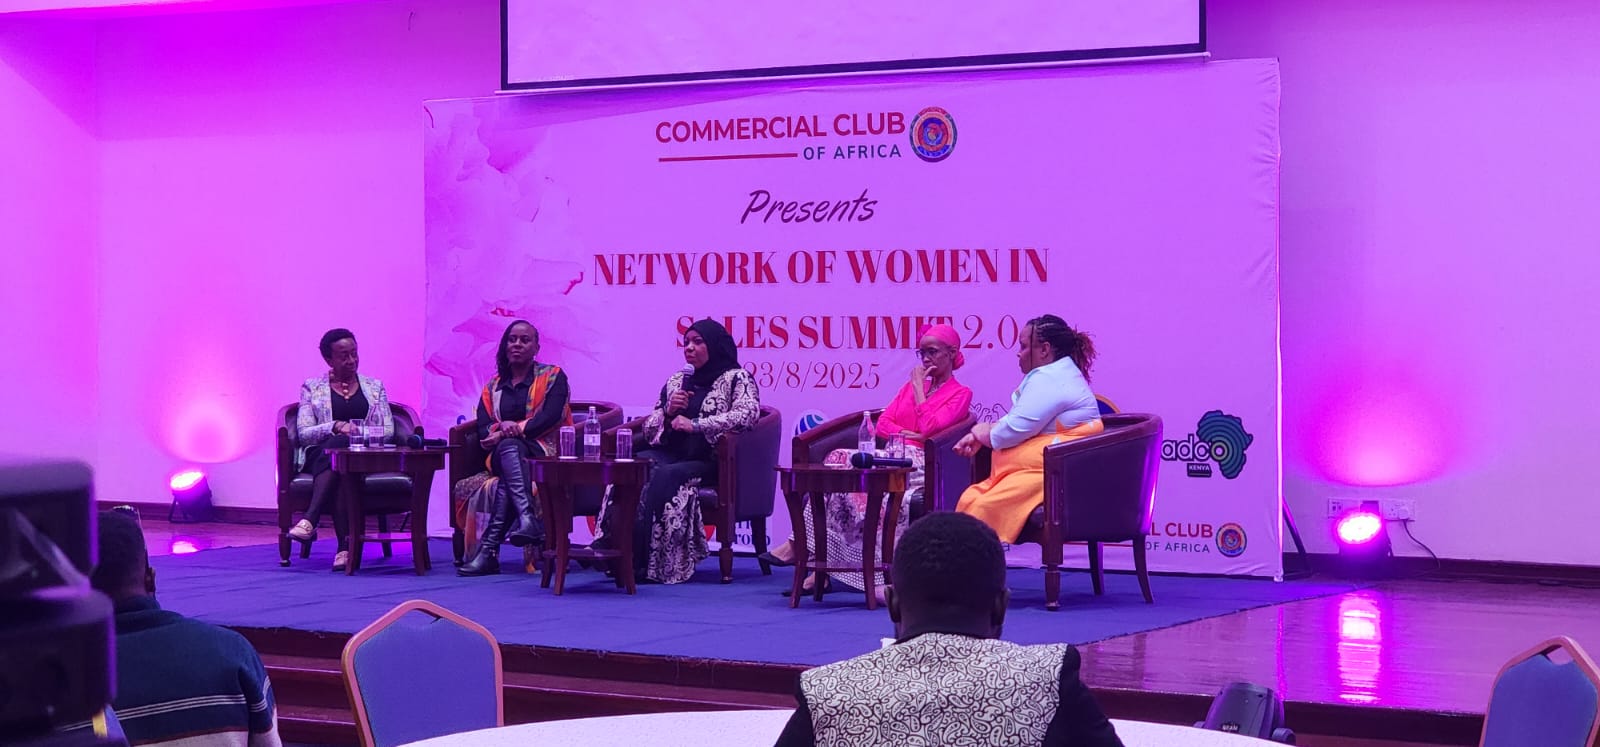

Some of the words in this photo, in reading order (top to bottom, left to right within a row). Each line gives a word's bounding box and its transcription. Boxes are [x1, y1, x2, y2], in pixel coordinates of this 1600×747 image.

[655, 115, 827, 144] COMMERCIAL
[833, 111, 906, 137] CLUB
[803, 146, 826, 160] OF
[833, 144, 902, 160] AFRICA
[740, 188, 879, 225] Presents
[593, 251, 780, 286] NETWORK
[787, 250, 836, 285] OF
[845, 248, 999, 284] WOMEN
[1008, 248, 1050, 283] IN
[676, 315, 789, 349] SLES
[798, 315, 953, 350] SUMMI
[963, 314, 1019, 350] 2.0
[1165, 522, 1213, 538] CLUB
[1145, 541, 1160, 551] OF
[1165, 542, 1210, 553] AFRICA
